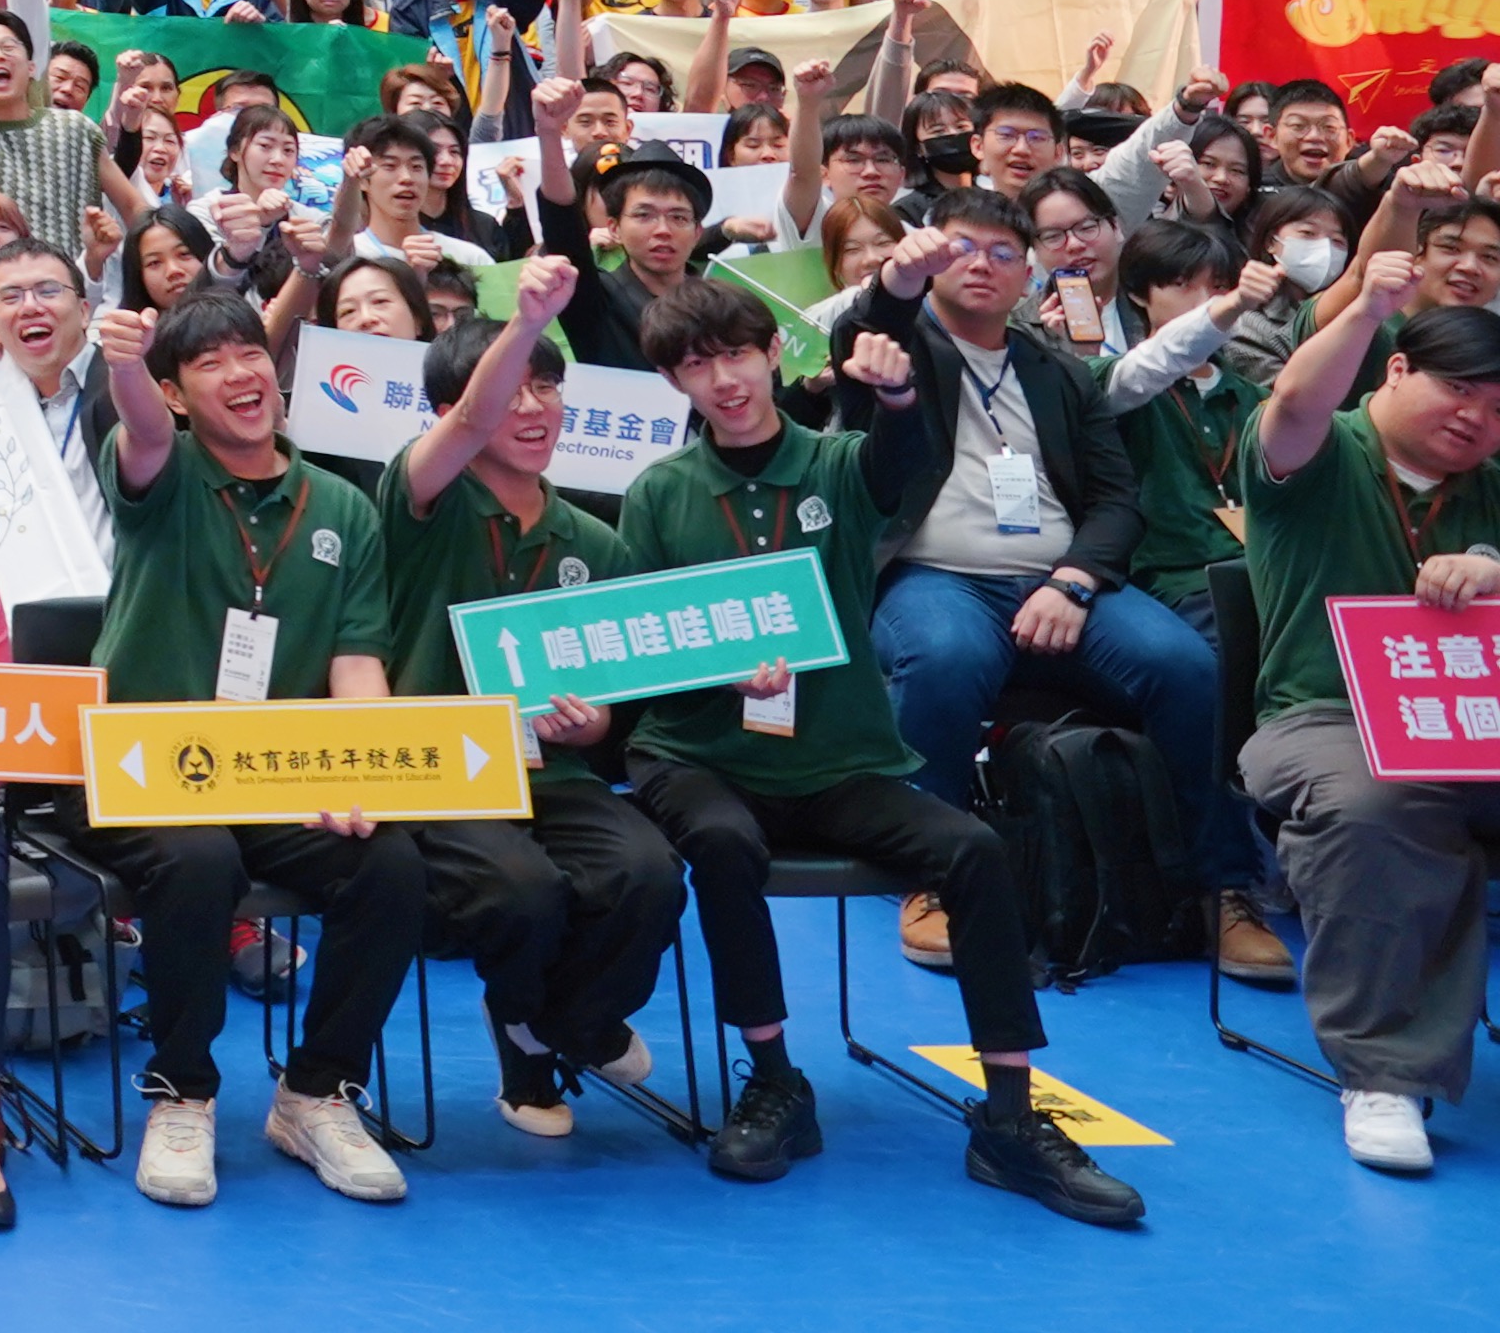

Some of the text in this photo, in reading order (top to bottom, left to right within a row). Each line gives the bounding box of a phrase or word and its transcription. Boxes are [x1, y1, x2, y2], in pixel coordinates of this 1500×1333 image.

[1382, 634, 1500, 680] 注意
[232, 746, 441, 772] 教育部青年發展署
